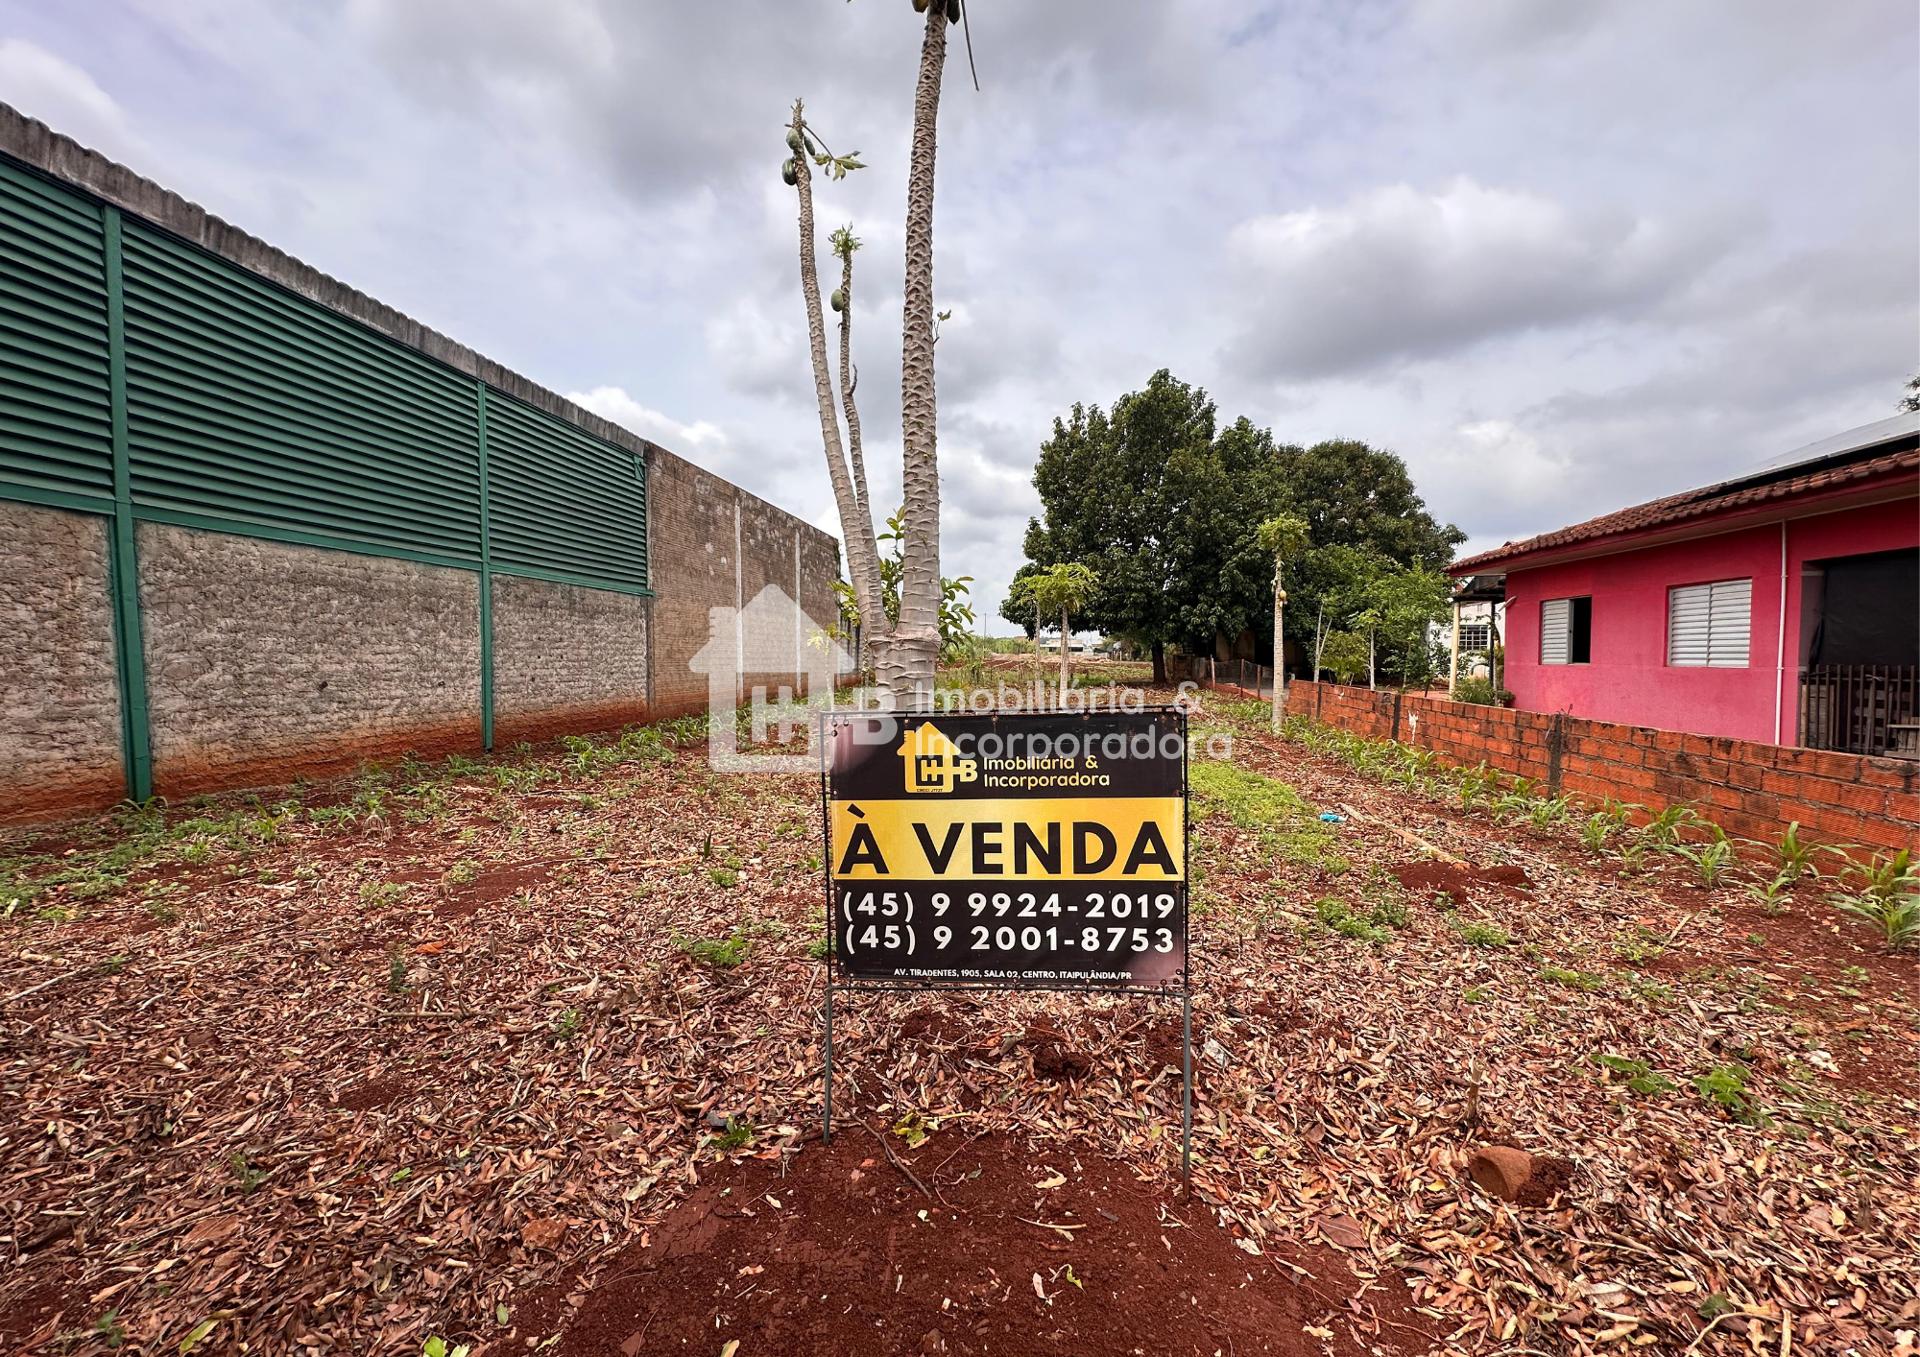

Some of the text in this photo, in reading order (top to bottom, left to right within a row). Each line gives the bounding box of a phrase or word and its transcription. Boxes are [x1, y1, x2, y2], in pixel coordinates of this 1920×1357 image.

[984, 755, 1099, 771] Imobiliária &
[984, 772, 1110, 789] Incorporadora
[838, 803, 1178, 875] À VENDA
[843, 891, 1175, 922] (45) 9 9924-2019
[845, 924, 1175, 955] (45) 9 2001-8753
[893, 968, 1132, 981] AV. TIRADENTES, 1905, SALA 02, CENTRO, ITAIPULÂNDIA/PR
